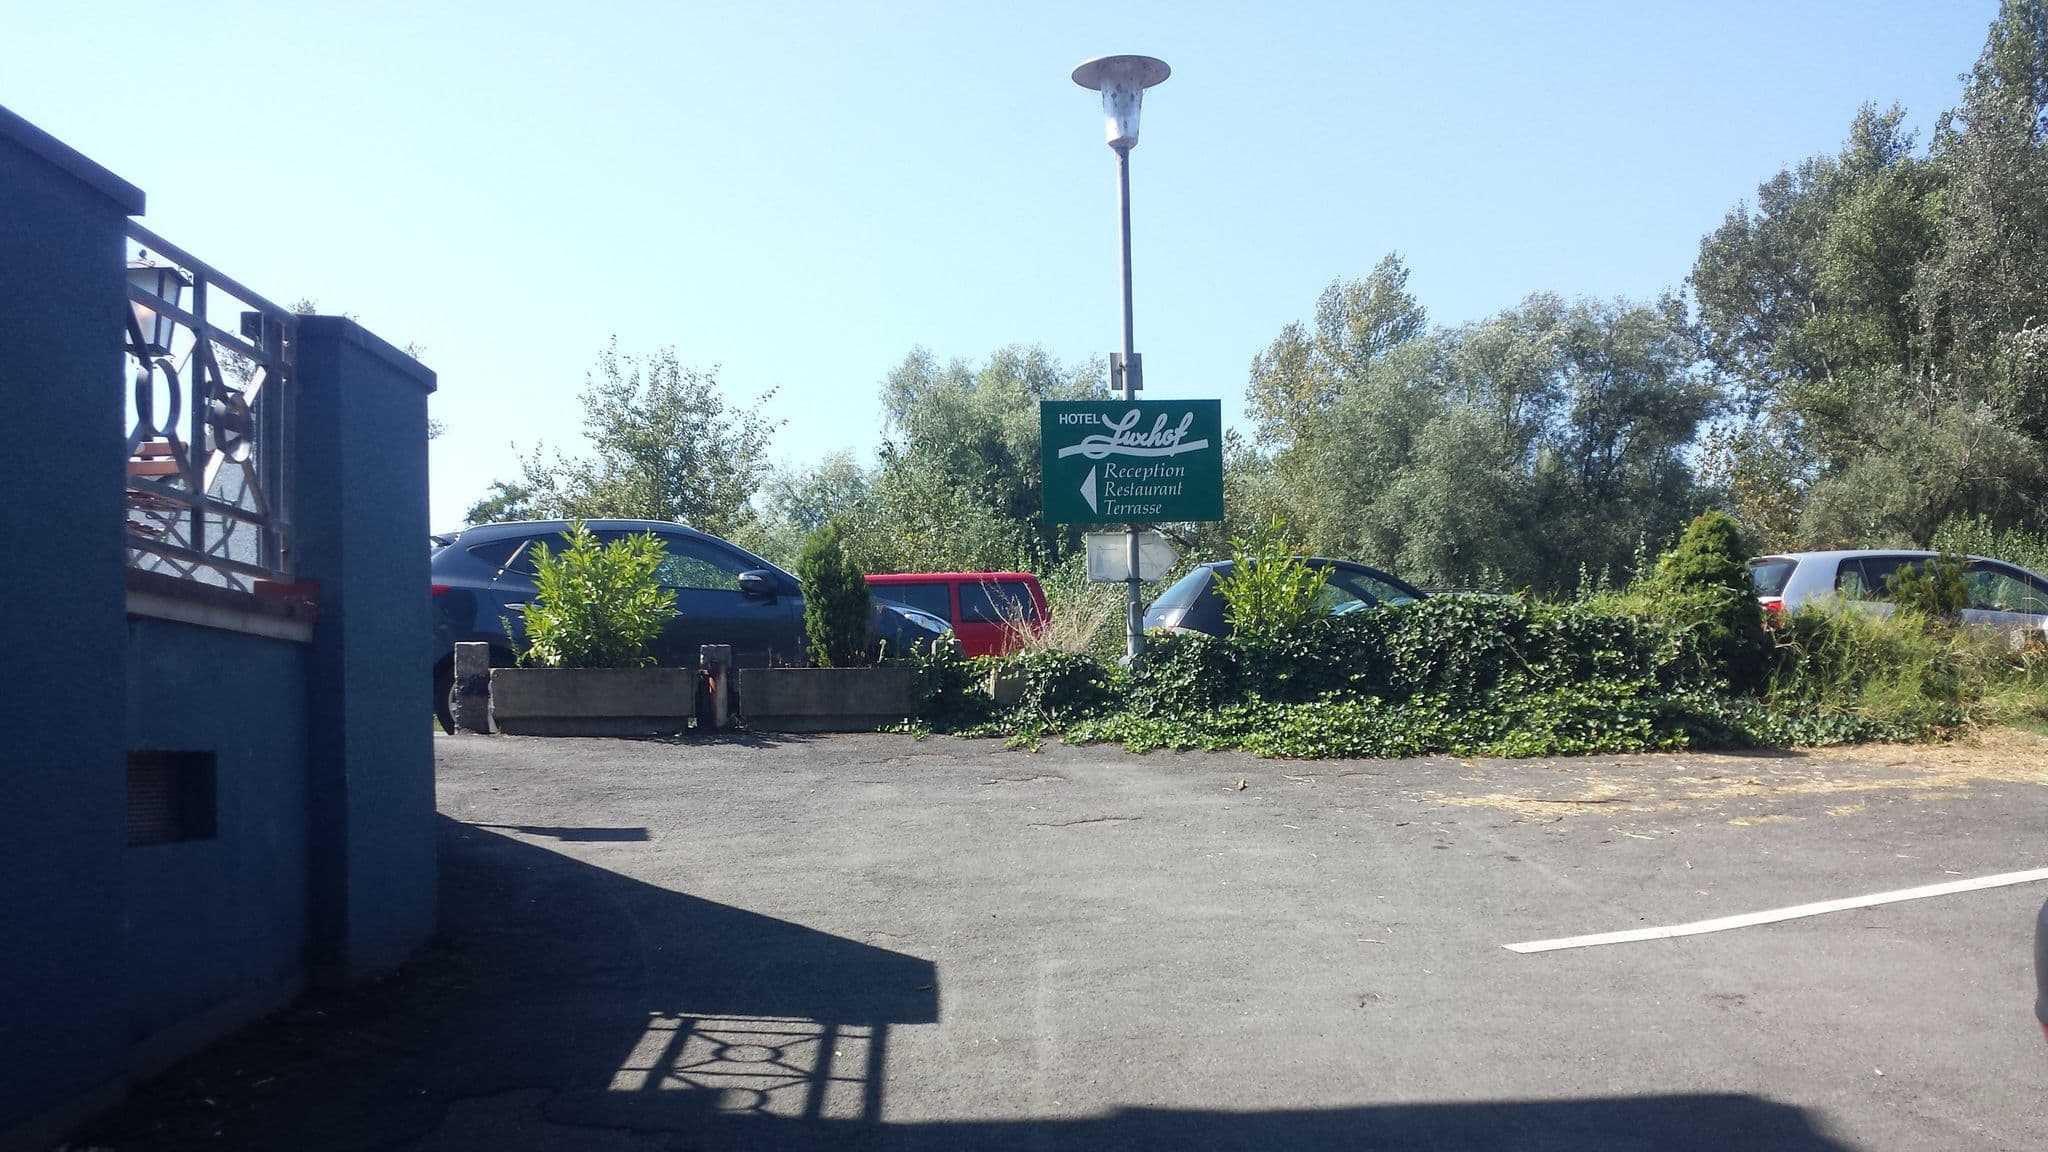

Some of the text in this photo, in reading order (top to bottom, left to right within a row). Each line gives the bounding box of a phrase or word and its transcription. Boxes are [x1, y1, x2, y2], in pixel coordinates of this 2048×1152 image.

[1059, 408, 1194, 457] HOTEL Luxhof
[1104, 463, 1185, 481] Reception
[1104, 481, 1183, 497] Restaurant
[1104, 499, 1162, 515] Terrasse
